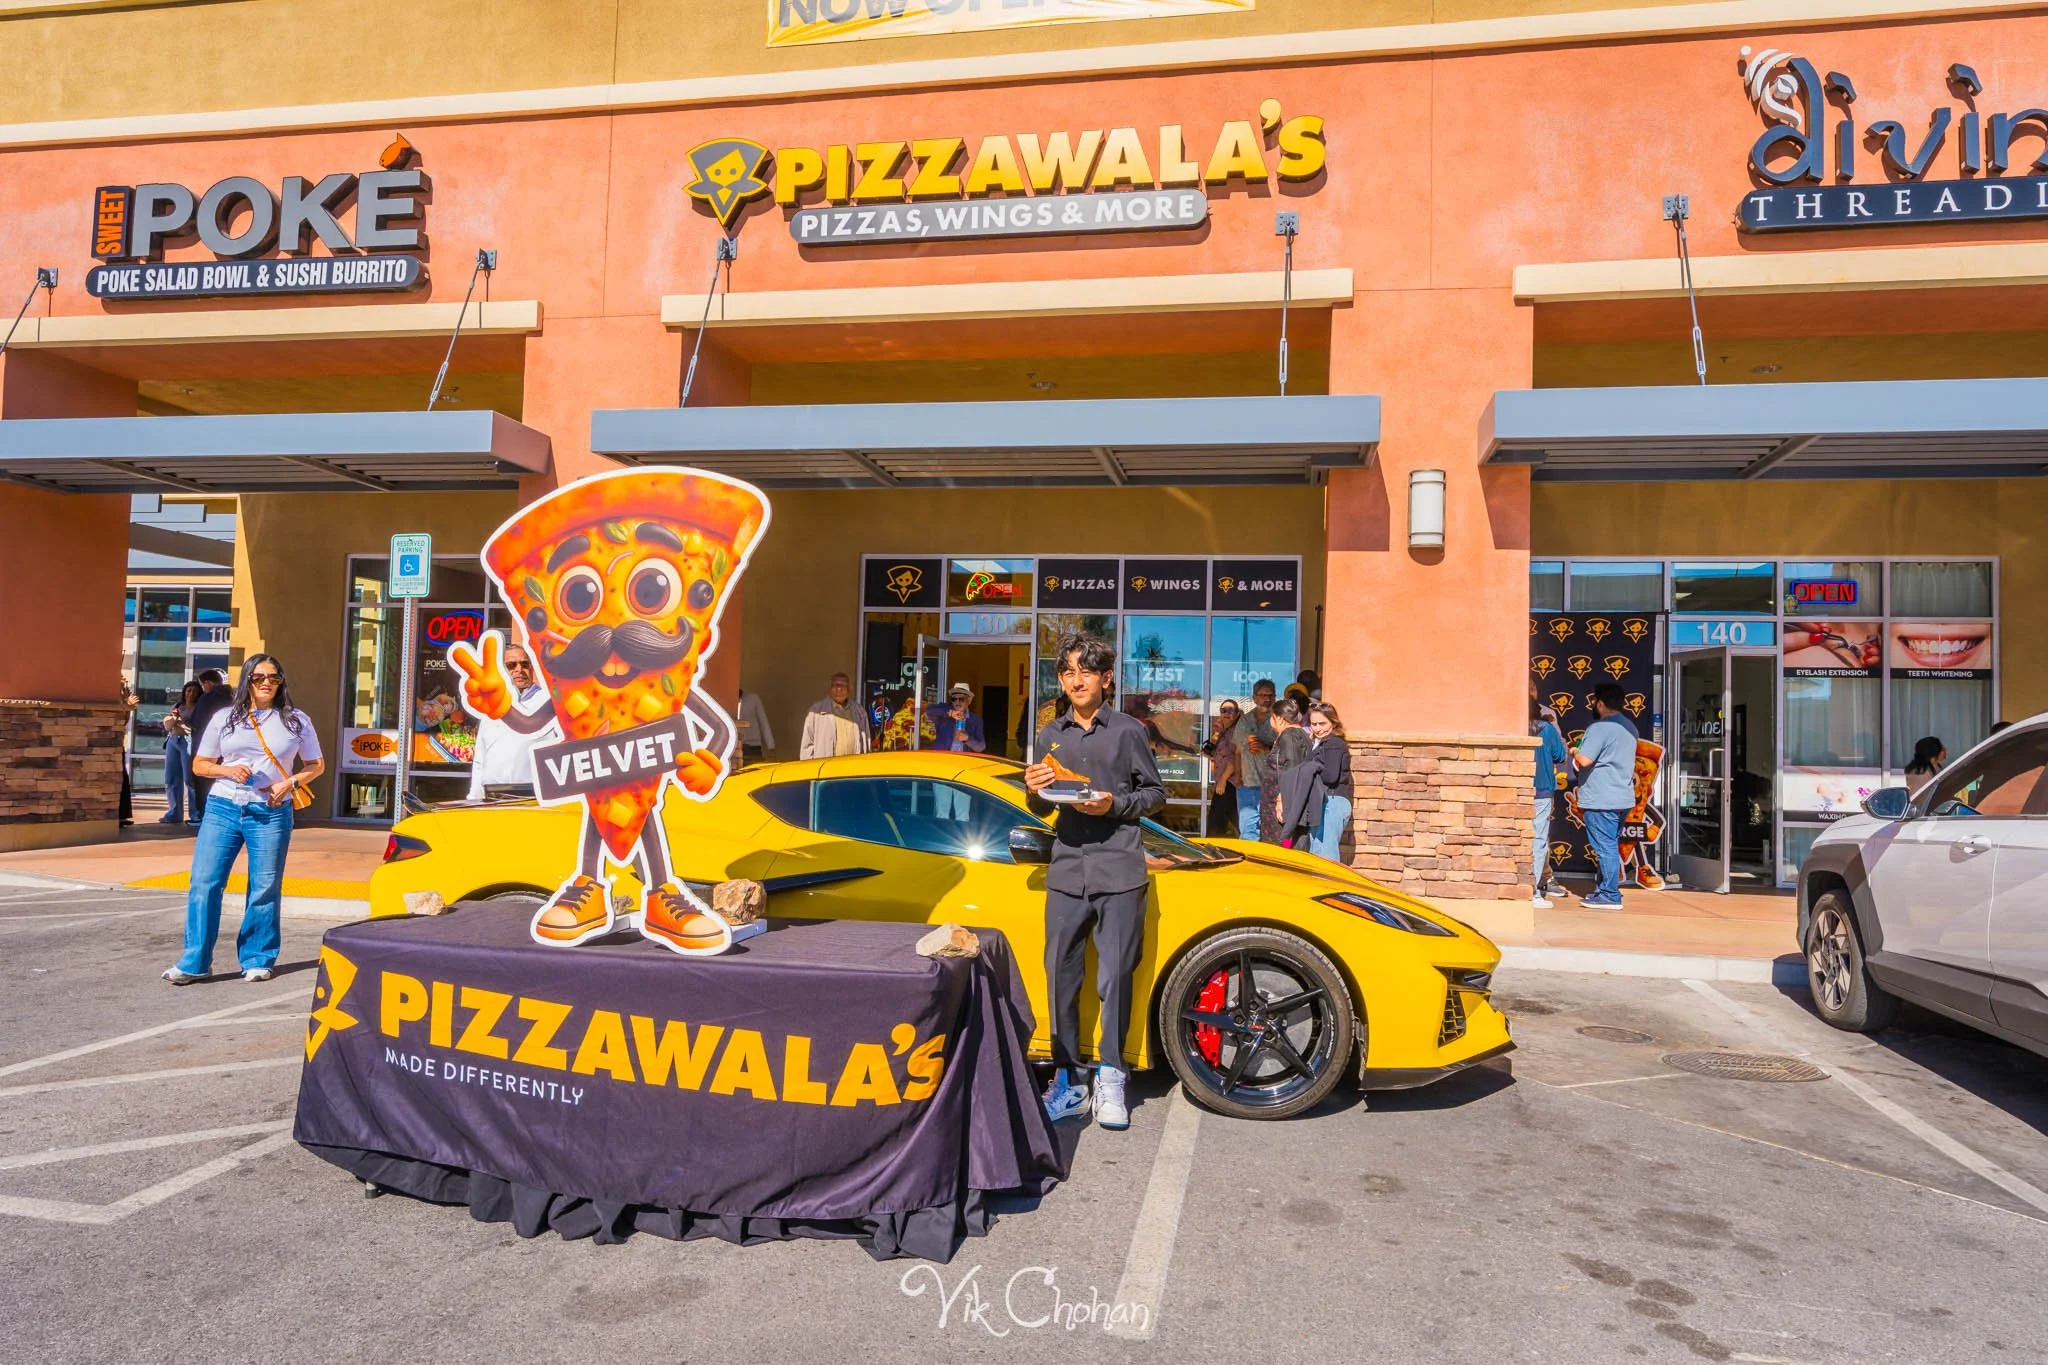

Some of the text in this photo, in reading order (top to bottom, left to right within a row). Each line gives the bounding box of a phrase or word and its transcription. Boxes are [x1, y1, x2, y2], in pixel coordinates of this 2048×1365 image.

[775, 98, 1326, 203] PIZZAWALA'S
[96, 188, 126, 255] SWEET
[801, 195, 1195, 237] PIZZAS, WINGS & MORE
[97, 258, 407, 293] POKE SALAD BOWL & SUSHI BURRITO
[982, 584, 1022, 598] OPEN
[1062, 579, 1116, 591] PIZZAS
[1150, 579, 1201, 591] WINGS
[1237, 580, 1293, 591] & MORE
[1794, 583, 1855, 601] OPEN
[427, 616, 482, 640] OPEN
[970, 614, 1009, 635] 130
[1697, 622, 1747, 645] 140
[1142, 668, 1185, 683] ZEST
[1796, 669, 1869, 677] EYELASH EXTENSION
[1931, 670, 1974, 678] WHITENING
[544, 732, 676, 787] VELVET
[380, 970, 947, 1107] PIZZAWALA'S
[385, 1046, 584, 1106] MADE DIFFERENTLY
